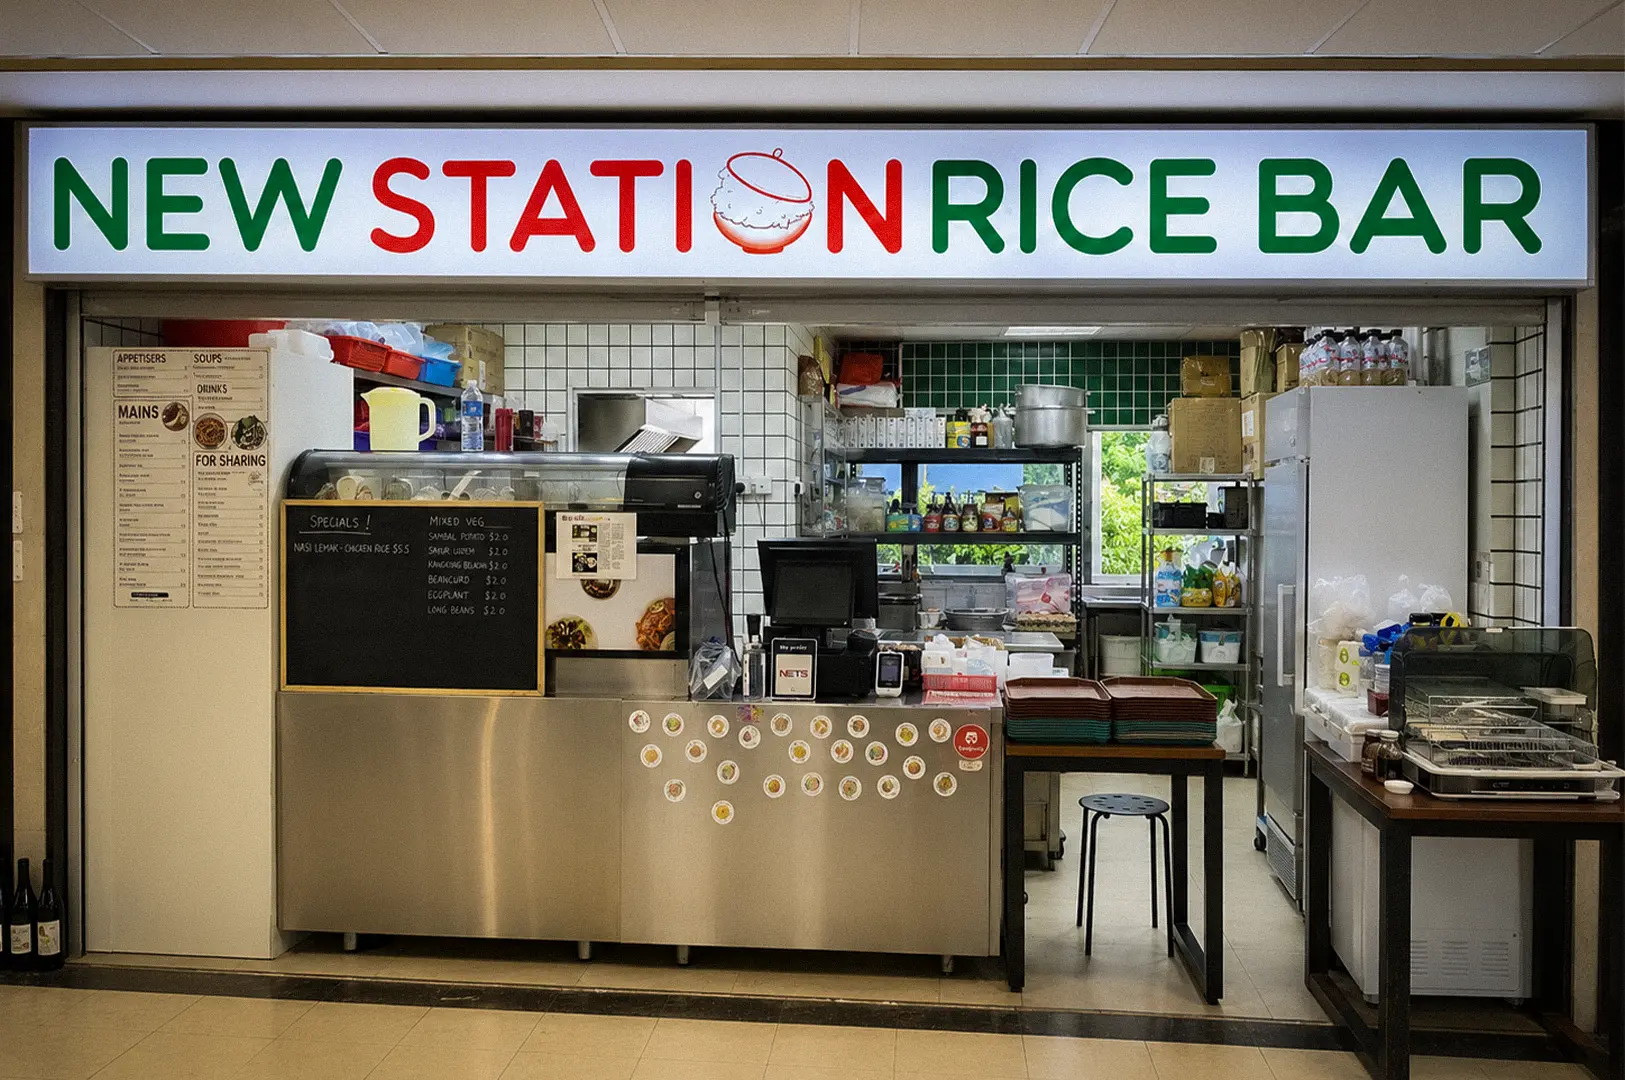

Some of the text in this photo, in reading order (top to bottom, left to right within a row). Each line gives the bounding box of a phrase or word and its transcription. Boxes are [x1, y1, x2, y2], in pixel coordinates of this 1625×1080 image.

[53, 157, 343, 252] NEW
[932, 157, 1217, 255] RICE
[1258, 157, 1542, 255] BAR
[116, 353, 167, 364] APPETISERS
[193, 353, 223, 364] SOUPS
[196, 383, 228, 394] DRINKS
[118, 404, 159, 420] MAINS
[195, 454, 266, 467] FOR SHARING
[310, 514, 359, 529] SPECIALS
[429, 515, 485, 528] MIXED VEG
[293, 542, 312, 553] NASI
[314, 543, 339, 554] LEMAK
[374, 543, 390, 554] RICE
[427, 574, 470, 585] BEANCURD
[427, 590, 469, 600] EGGPLANT
[427, 605, 447, 615] LONG
[450, 605, 475, 615] BEANS
[779, 669, 809, 678] NETS
